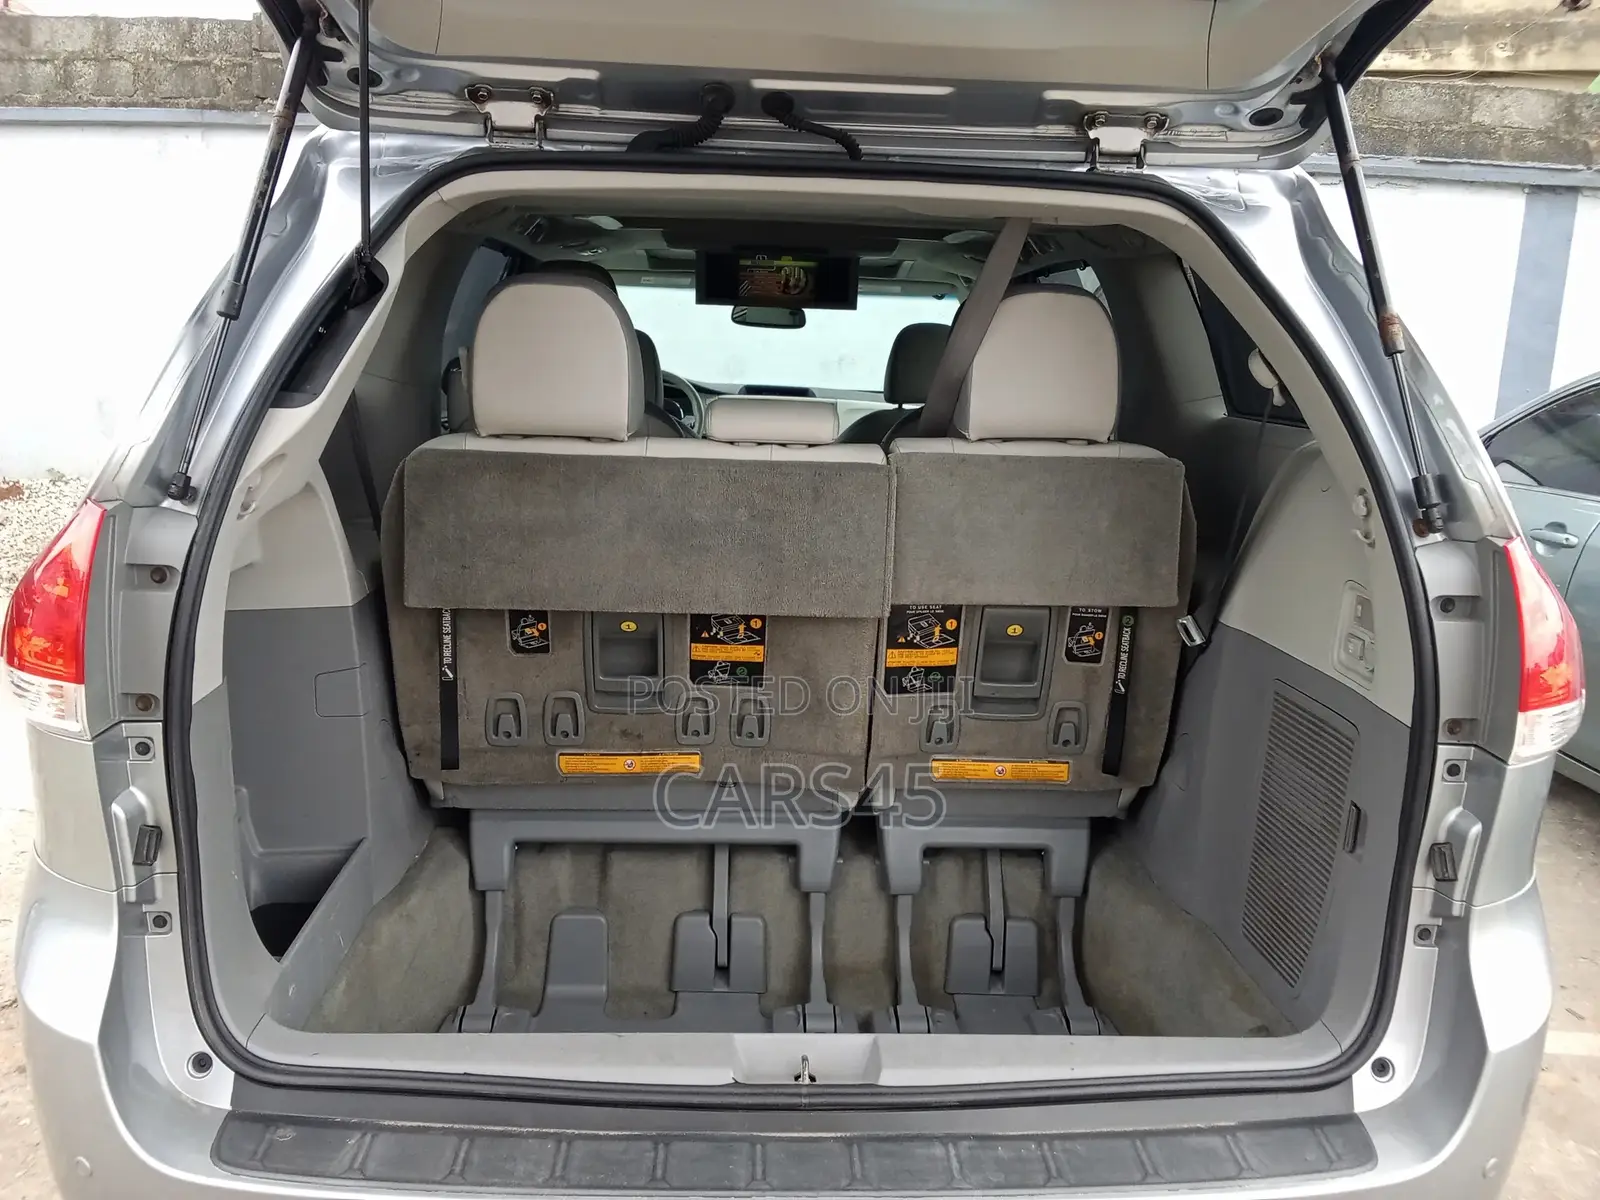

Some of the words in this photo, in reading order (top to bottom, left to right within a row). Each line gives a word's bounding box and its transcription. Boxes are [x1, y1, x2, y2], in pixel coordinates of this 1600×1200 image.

[442, 608, 452, 633] SEATBAC
[443, 634, 452, 657] RECLINE
[1121, 627, 1132, 652] SEATBACK
[1118, 652, 1129, 673] RECLINE
[1117, 672, 1126, 680] TO
